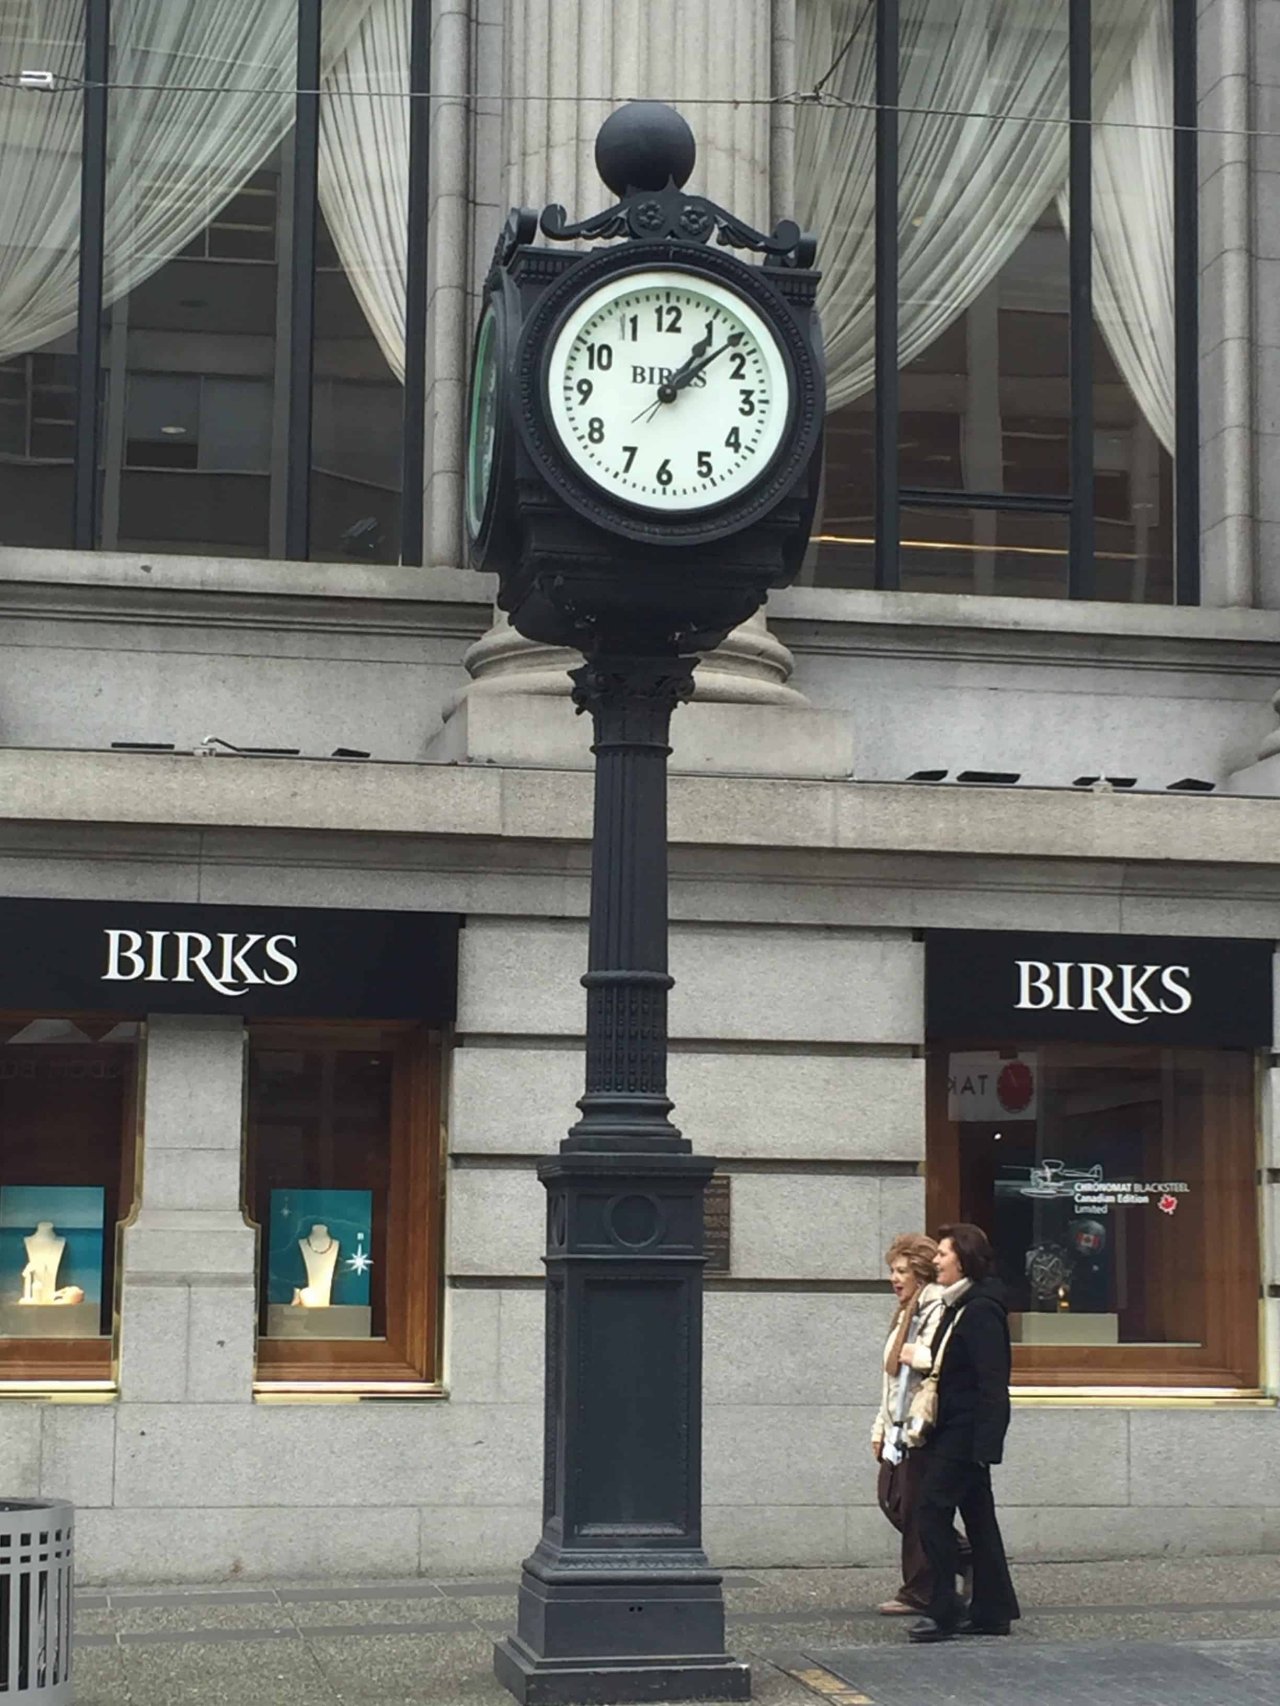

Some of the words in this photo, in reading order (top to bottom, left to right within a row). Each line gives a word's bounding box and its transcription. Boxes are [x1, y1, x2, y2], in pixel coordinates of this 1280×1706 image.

[619, 312, 639, 341] 11
[654, 305, 682, 333] 12
[704, 320, 713, 346] 1
[586, 343, 613, 371] 10
[729, 352, 747, 380] 2
[630, 365, 707, 389] BIRS
[576, 378, 593, 405] 9
[738, 389, 755, 416] 3
[587, 417, 605, 444] 8
[725, 426, 742, 453] 4
[622, 446, 639, 474] 7
[656, 459, 673, 486] 6
[697, 451, 713, 478] 5
[101, 929, 298, 996] BIRKS
[1013, 961, 1192, 1024] BIRKS
[1074, 1182, 1132, 1192] CHRONOMAT
[1133, 1182, 1190, 1193] BLACKSTEEL
[1074, 1193, 1116, 1203] Canadian
[1117, 1193, 1149, 1204] Edition
[1074, 1204, 1108, 1214] Limited
